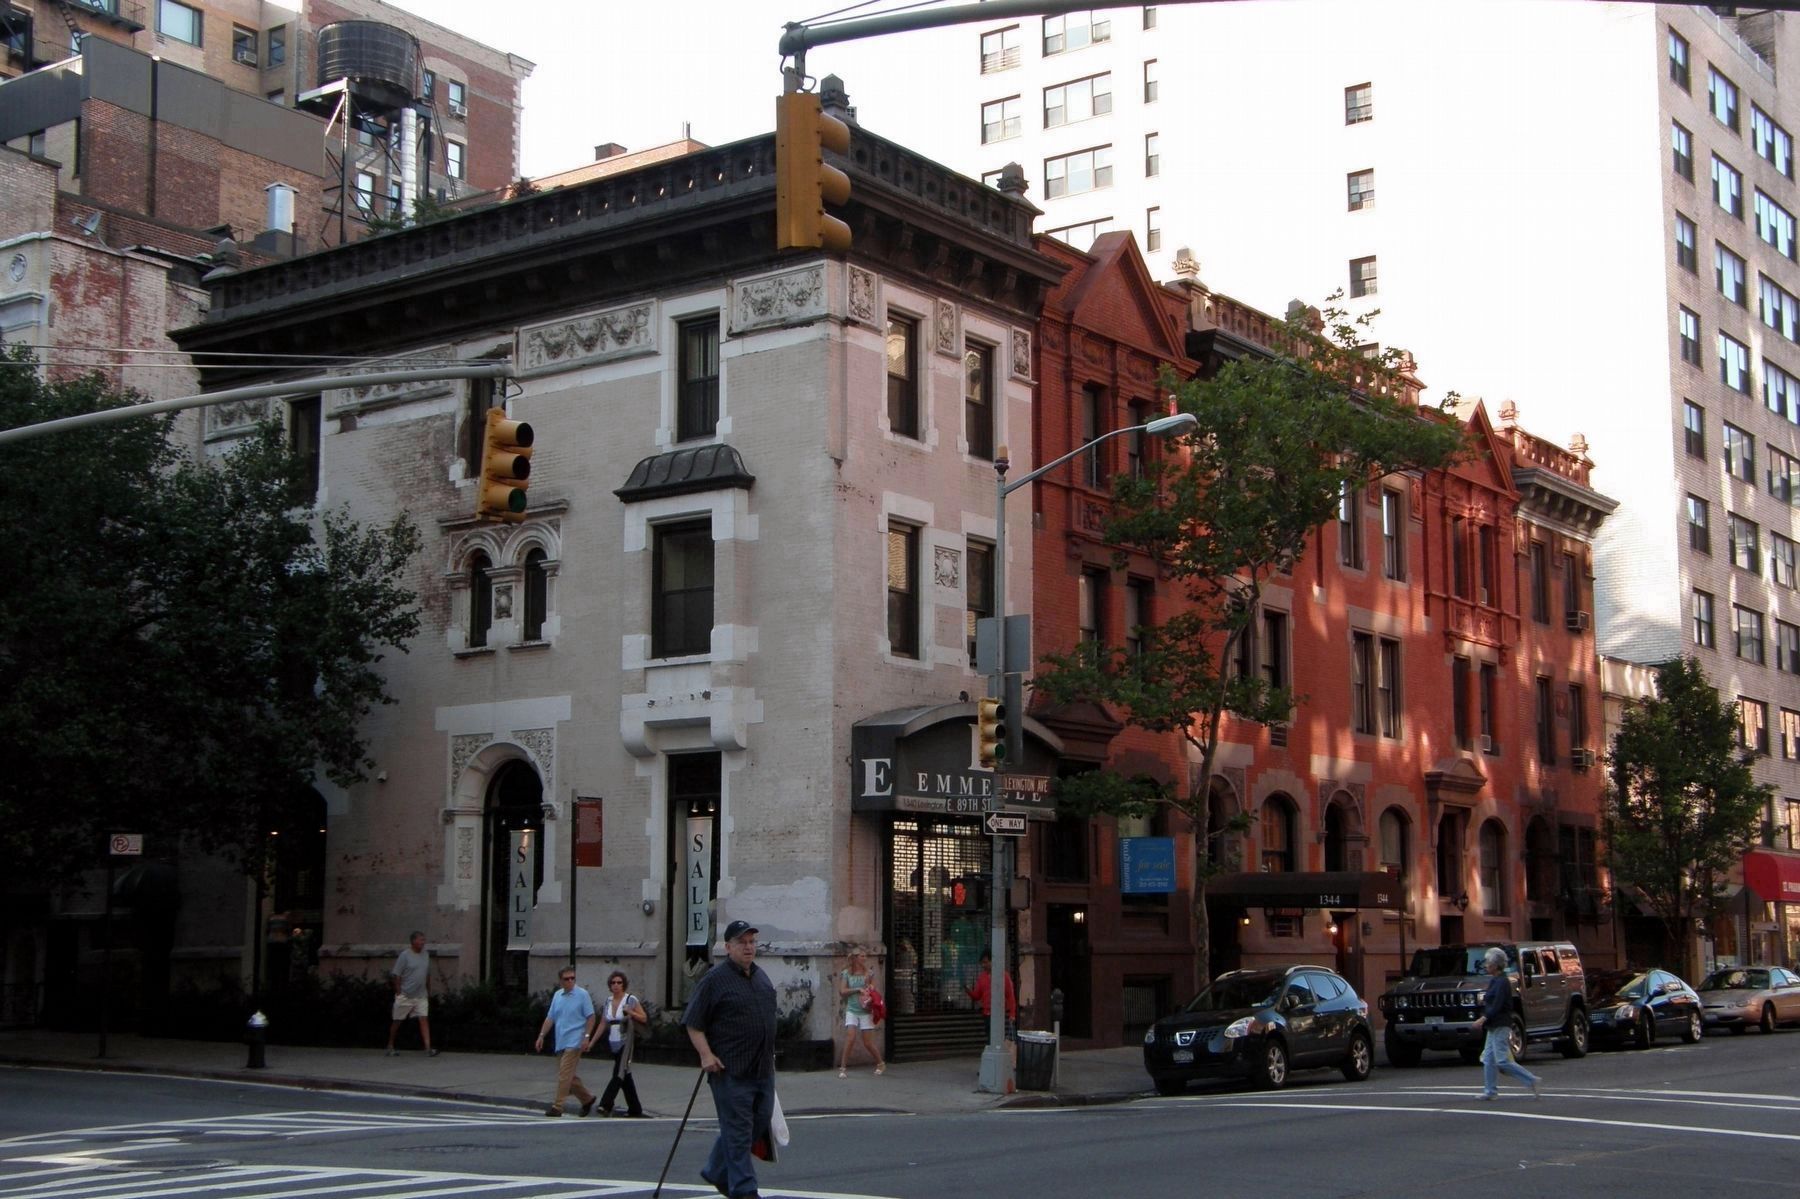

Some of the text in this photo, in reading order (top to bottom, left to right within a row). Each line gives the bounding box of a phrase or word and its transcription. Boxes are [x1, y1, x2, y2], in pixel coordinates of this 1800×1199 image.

[861, 758, 892, 797] E
[1004, 777, 1048, 793] LEXINGTON AVE
[947, 798, 992, 811] E 89TH ST
[991, 817, 1022, 828] ONE WAY
[691, 833, 704, 932] SALE
[514, 846, 527, 938] SALE
[1319, 894, 1341, 905] 1344
